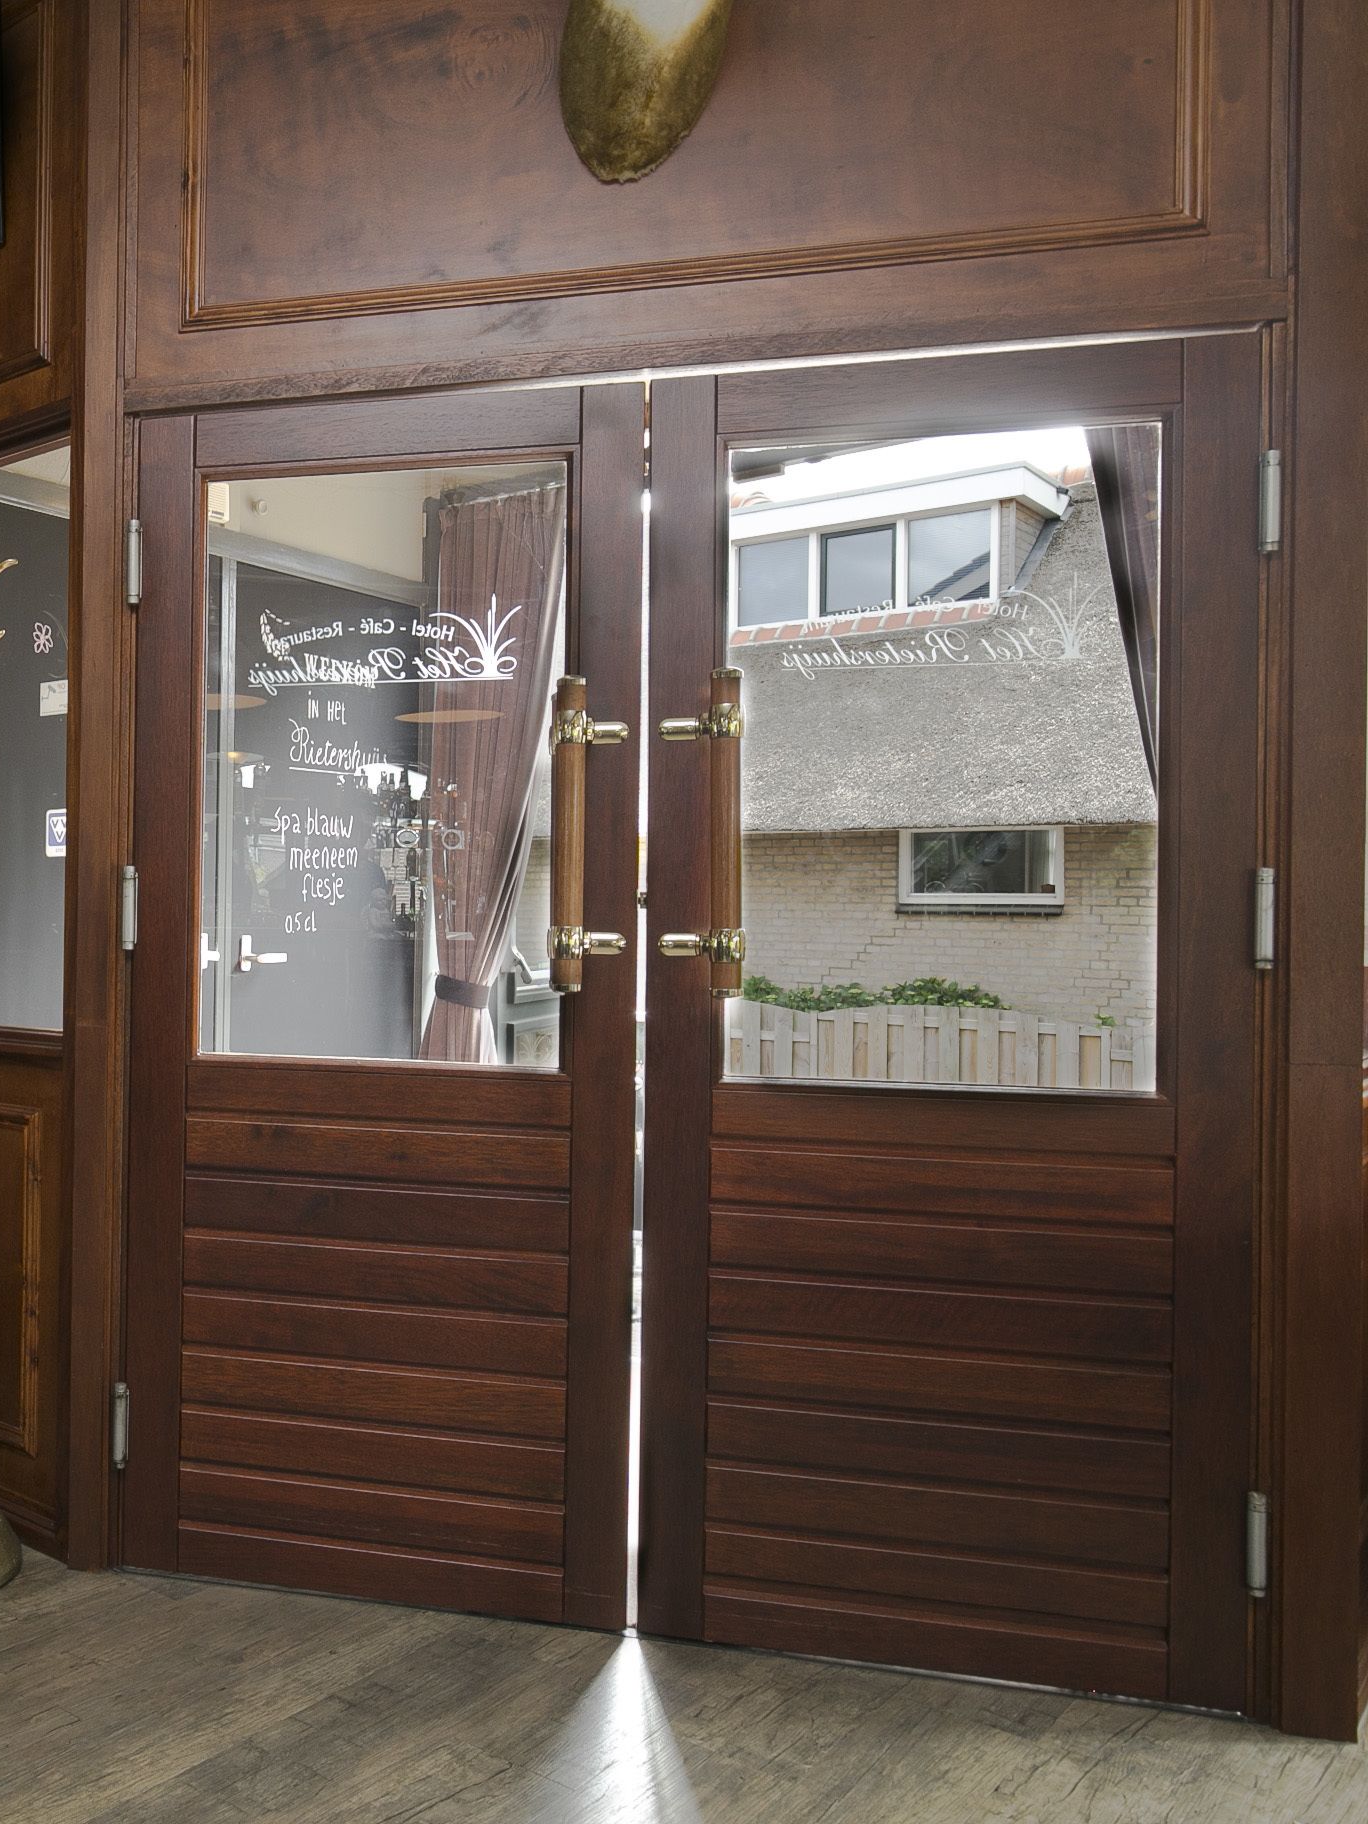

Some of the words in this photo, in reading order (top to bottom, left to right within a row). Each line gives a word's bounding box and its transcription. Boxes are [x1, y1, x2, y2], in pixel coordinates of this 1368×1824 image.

[270, 806, 302, 845] Spa
[306, 806, 354, 839] blauw
[289, 846, 359, 871] meeneem
[301, 872, 345, 906] flesje
